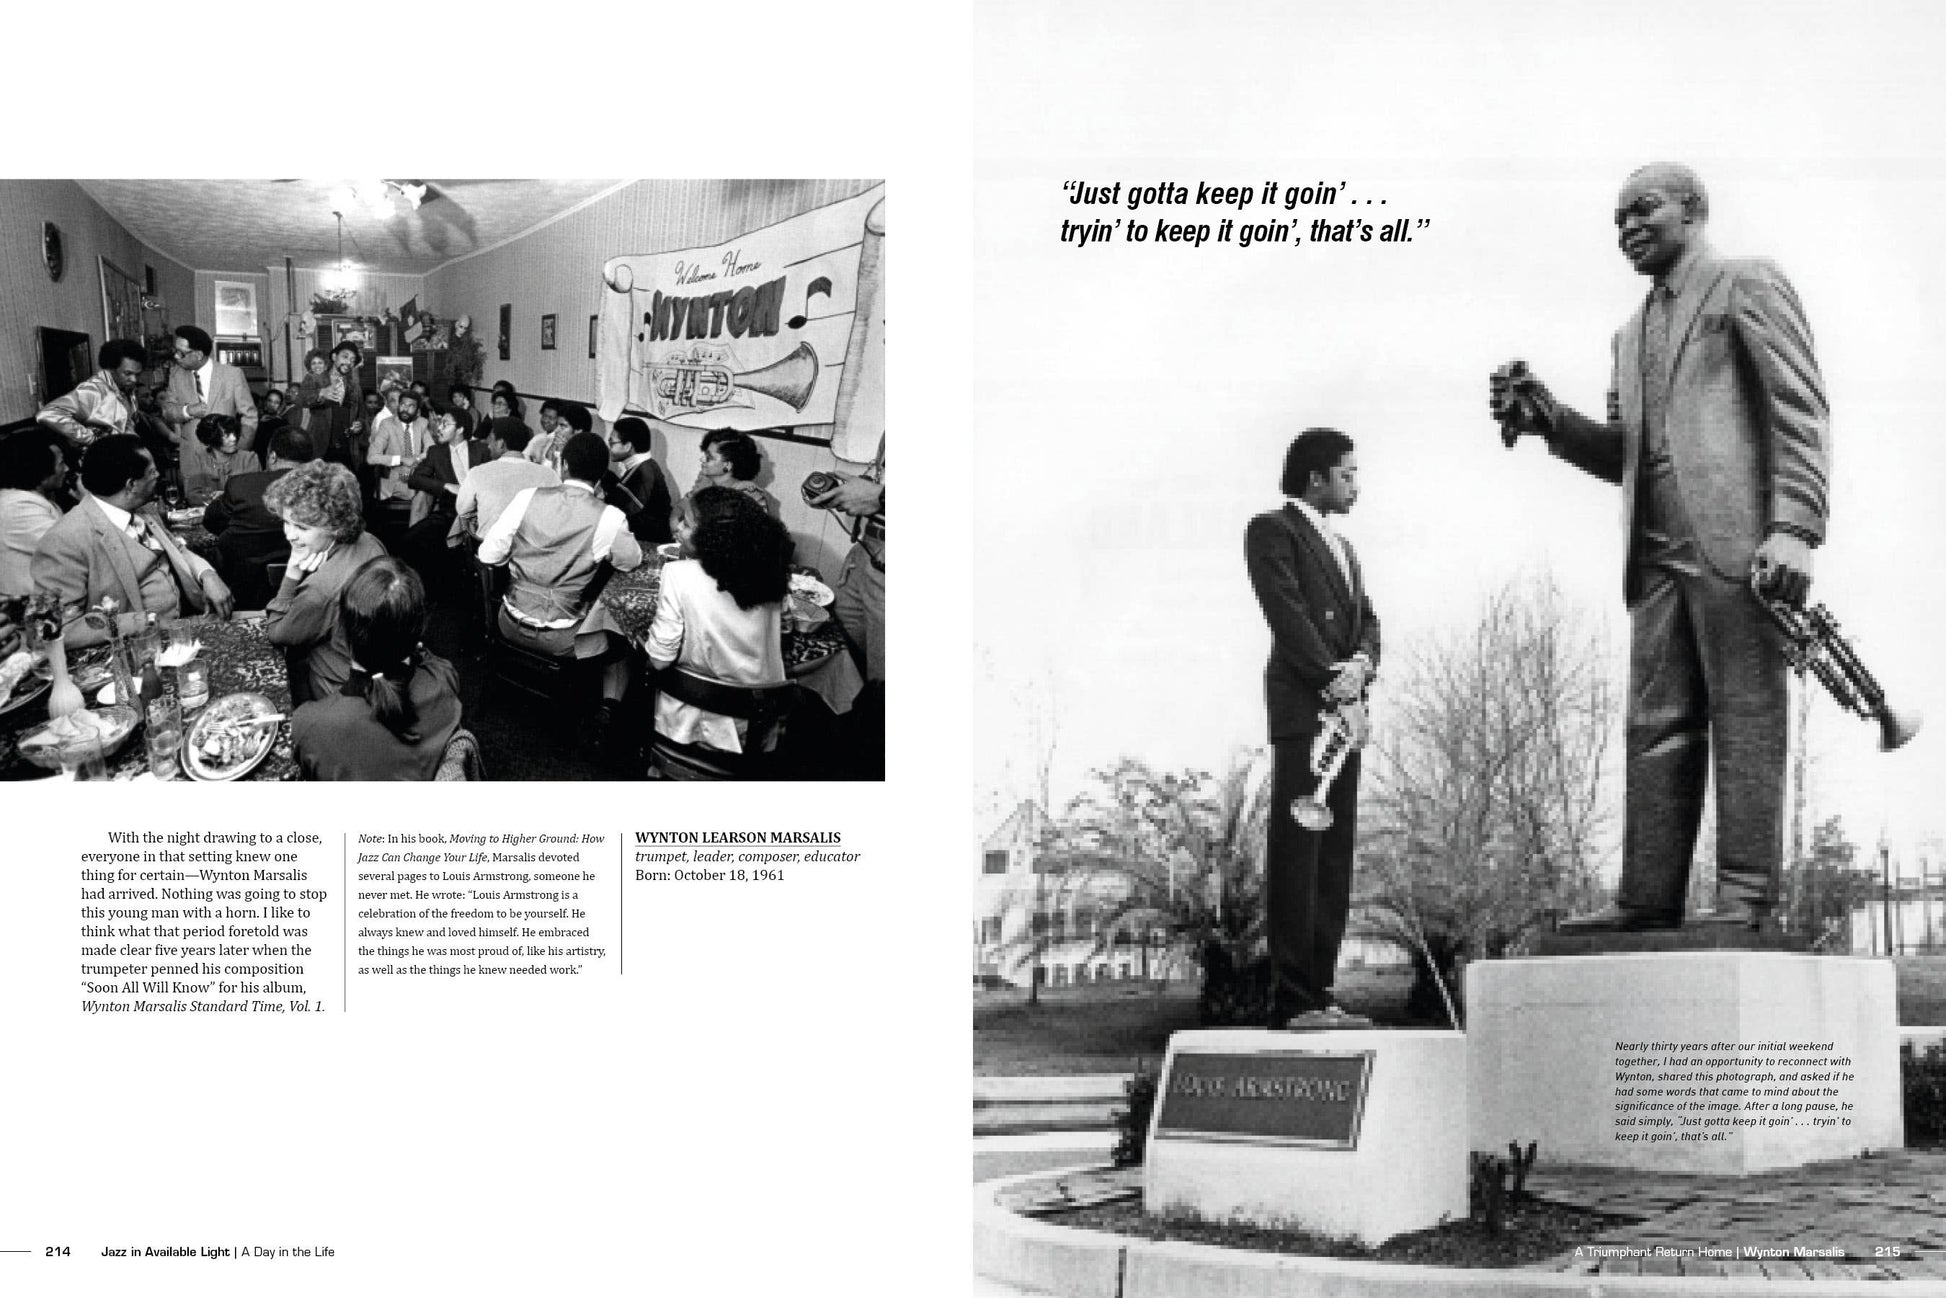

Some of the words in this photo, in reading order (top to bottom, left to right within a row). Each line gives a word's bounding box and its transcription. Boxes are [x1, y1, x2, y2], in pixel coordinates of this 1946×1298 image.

[675, 260, 717, 286] Welcome
[722, 249, 762, 278] Home
[650, 275, 786, 342] WYNTON
[107, 830, 140, 844] With
[142, 830, 164, 844] the
[166, 830, 201, 847] night
[203, 830, 257, 847] drawing
[259, 832, 273, 844] to
[275, 834, 284, 844] a
[286, 830, 323, 846] close,
[358, 833, 385, 844] Note:
[387, 833, 399, 844] In
[400, 833, 417, 844] his
[418, 833, 448, 845] book,
[449, 833, 487, 847] Moving
[489, 834, 500, 844] to
[501, 833, 538, 847] Higher
[538, 833, 580, 844] Ground:
[581, 833, 606, 844] How
[635, 831, 699, 844] WYNTON
[702, 831, 767, 844] LEARSON
[770, 831, 842, 844] MARSALIS
[81, 853, 141, 865] everyone
[143, 850, 156, 863] in
[158, 849, 186, 863] that
[188, 850, 233, 865] setting
[235, 849, 272, 863] knew
[274, 853, 298, 863] one
[356, 852, 380, 865] Jazz
[381, 852, 401, 863] Can
[403, 851, 442, 865] Change
[443, 852, 468, 863] Your
[468, 851, 490, 865] Life,
[492, 851, 536, 863] Marsalis
[538, 851, 580, 863] devoted
[635, 851, 690, 865] trumpet,
[693, 849, 735, 864] leader,
[738, 853, 801, 865] composer,
[804, 849, 861, 862] educator
[80, 868, 115, 884] thing
[117, 868, 137, 881] for
[139, 869, 251, 884] certain—Wynton
[253, 868, 308, 881] Marsalis
[358, 870, 395, 881] several
[397, 873, 427, 884] pages
[429, 872, 441, 881] to
[442, 871, 471, 881] Louis
[472, 871, 532, 884] Armstrong,
[533, 873, 581, 881] someone
[582, 870, 596, 881] he
[635, 869, 671, 881] Born:
[674, 868, 726, 881] October
[729, 869, 749, 883] 18,
[752, 869, 784, 881] 1961
[81, 887, 106, 900] had
[108, 887, 158, 900] arrived.
[161, 887, 214, 903] Nothing
[215, 890, 242, 900] was
[244, 887, 281, 903] going
[283, 888, 297, 900] to
[299, 888, 328, 903] stop
[358, 892, 388, 900] never
[389, 890, 413, 900] met.
[415, 889, 430, 900] He
[431, 891, 466, 900] wrote:
[467, 889, 501, 900] “Louis
[502, 890, 560, 903] Armstrong
[560, 890, 570, 900] is
[571, 892, 579, 900] a
[81, 981, 119, 994] “Soon
[121, 980, 139, 994] All
[142, 980, 169, 994] Will
[172, 980, 216, 994] Know”
[218, 980, 238, 994] for
[240, 980, 260, 994] his
[262, 980, 307, 995] album,
[81, 1000, 130, 1015] Wynton
[133, 999, 188, 1013] Marsalis
[189, 999, 249, 1013] Standard
[251, 1000, 286, 1014] Time,
[289, 999, 311, 1013] Vol.
[314, 1000, 325, 1012] 1.
[45, 1246, 71, 1257] 214
[100, 1246, 128, 1257] Jazz
[130, 1248, 142, 1257] in
[144, 1246, 197, 1257] Available
[200, 1246, 231, 1260] Light
[240, 1246, 251, 1257] A
[253, 1245, 276, 1260] Day
[278, 1246, 289, 1257] in
[292, 1246, 312, 1258] the
[314, 1245, 335, 1258] Life
